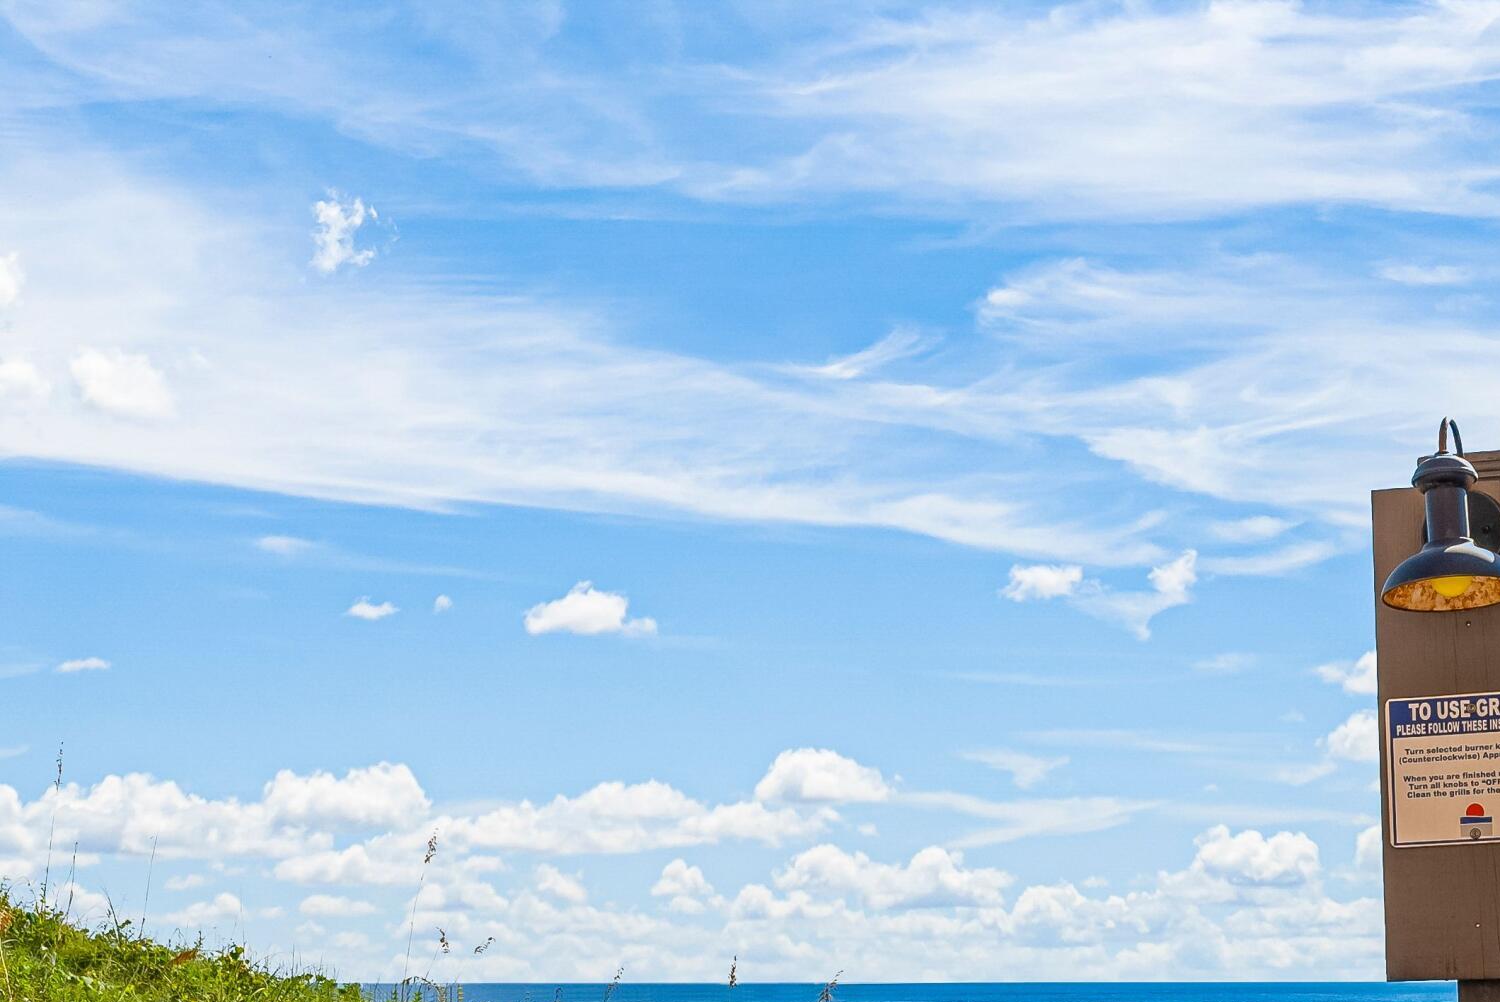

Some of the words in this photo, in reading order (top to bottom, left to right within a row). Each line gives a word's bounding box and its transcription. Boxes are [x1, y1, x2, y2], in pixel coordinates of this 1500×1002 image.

[1408, 702, 1432, 721] TO
[1436, 699, 1471, 719] USE
[1396, 723, 1427, 736] PLEASE
[1428, 721, 1460, 734] FOLLOW
[1461, 719, 1488, 732] THESE
[1426, 745, 1463, 754] selected
[1399, 752, 1480, 765] (Counterclockwise)
[1428, 775, 1444, 783] you
[1462, 770, 1496, 779] finished
[1443, 780, 1468, 788] knobs
[1449, 788, 1471, 797] grills
